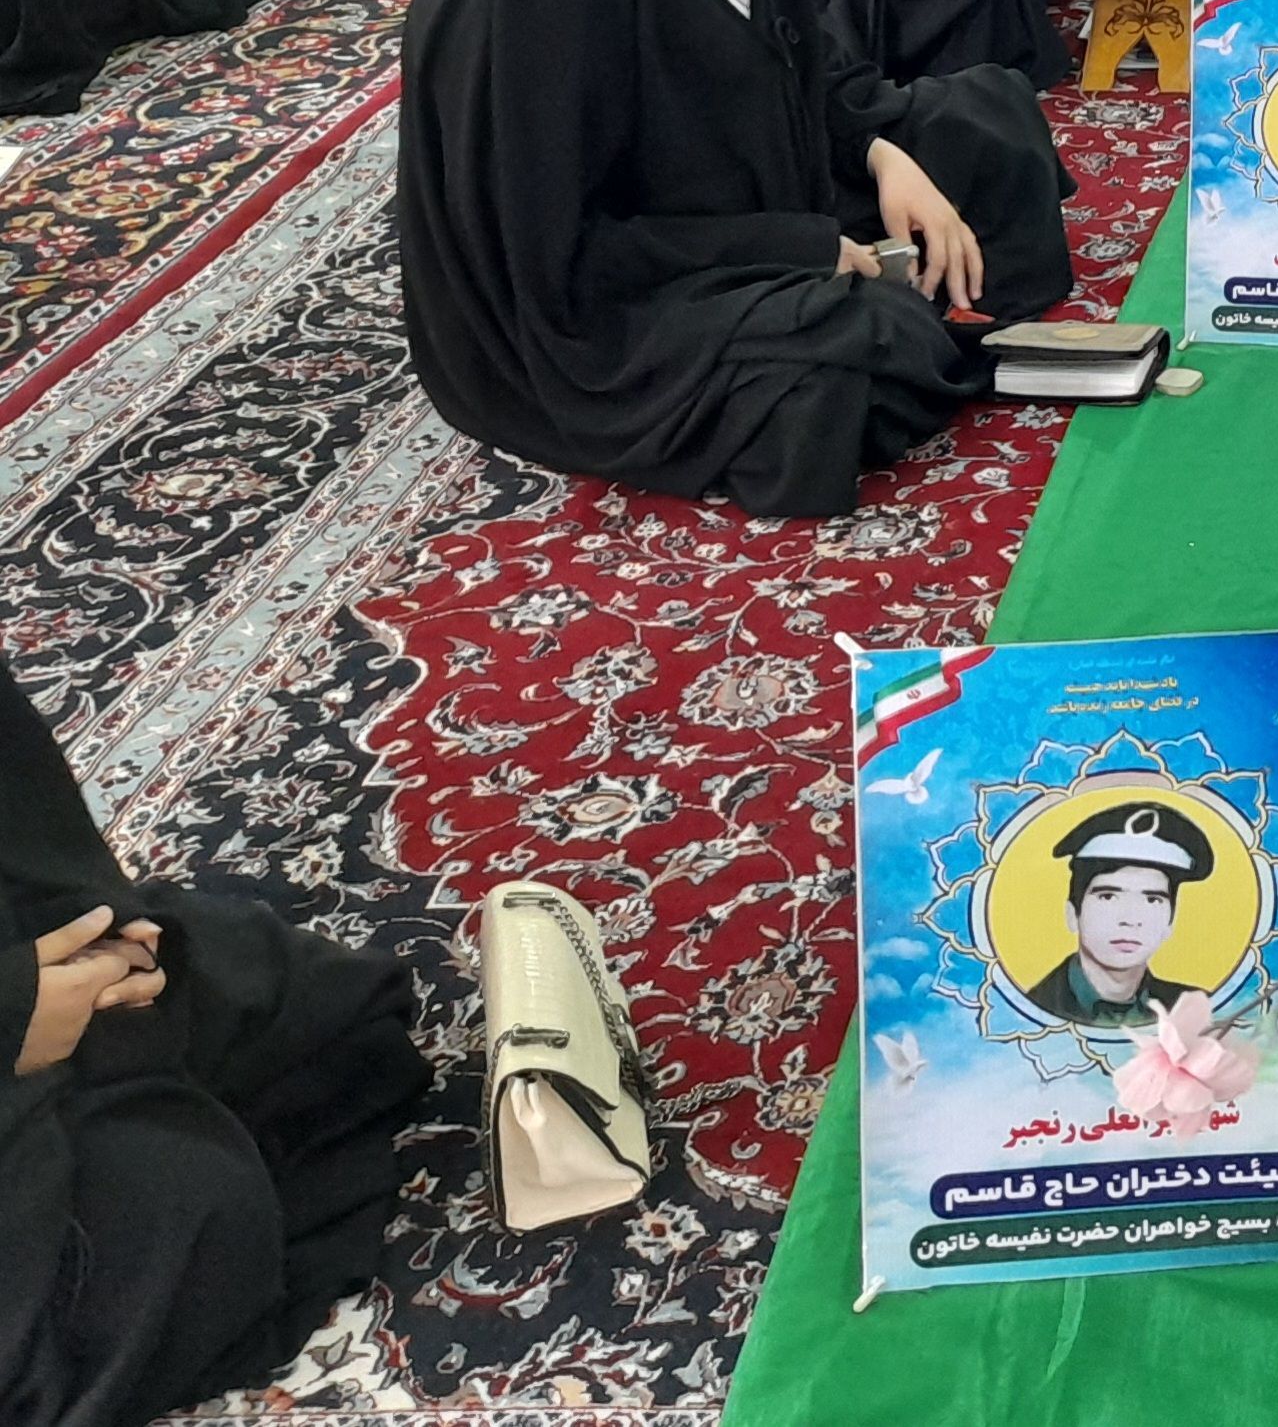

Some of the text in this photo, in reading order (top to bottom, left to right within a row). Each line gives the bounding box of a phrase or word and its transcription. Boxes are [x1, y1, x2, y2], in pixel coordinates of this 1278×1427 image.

[1214, 313, 1253, 328] خاتون
[1110, 697, 1146, 711] جامعه
[1186, 695, 1200, 710] در
[1001, 1109, 1077, 1149] رنجبر
[1196, 1100, 1241, 1134] شه
[943, 1174, 1037, 1212] قاسم
[1043, 1173, 1100, 1206] حاج
[1105, 1167, 1213, 1202] دختران
[985, 1225, 1052, 1251] نفیسه
[1057, 1223, 1119, 1250] حضرت
[1124, 1213, 1212, 1244] خواهران
[1217, 1210, 1272, 1240] بسیج
[915, 1233, 981, 1261] خاتون
